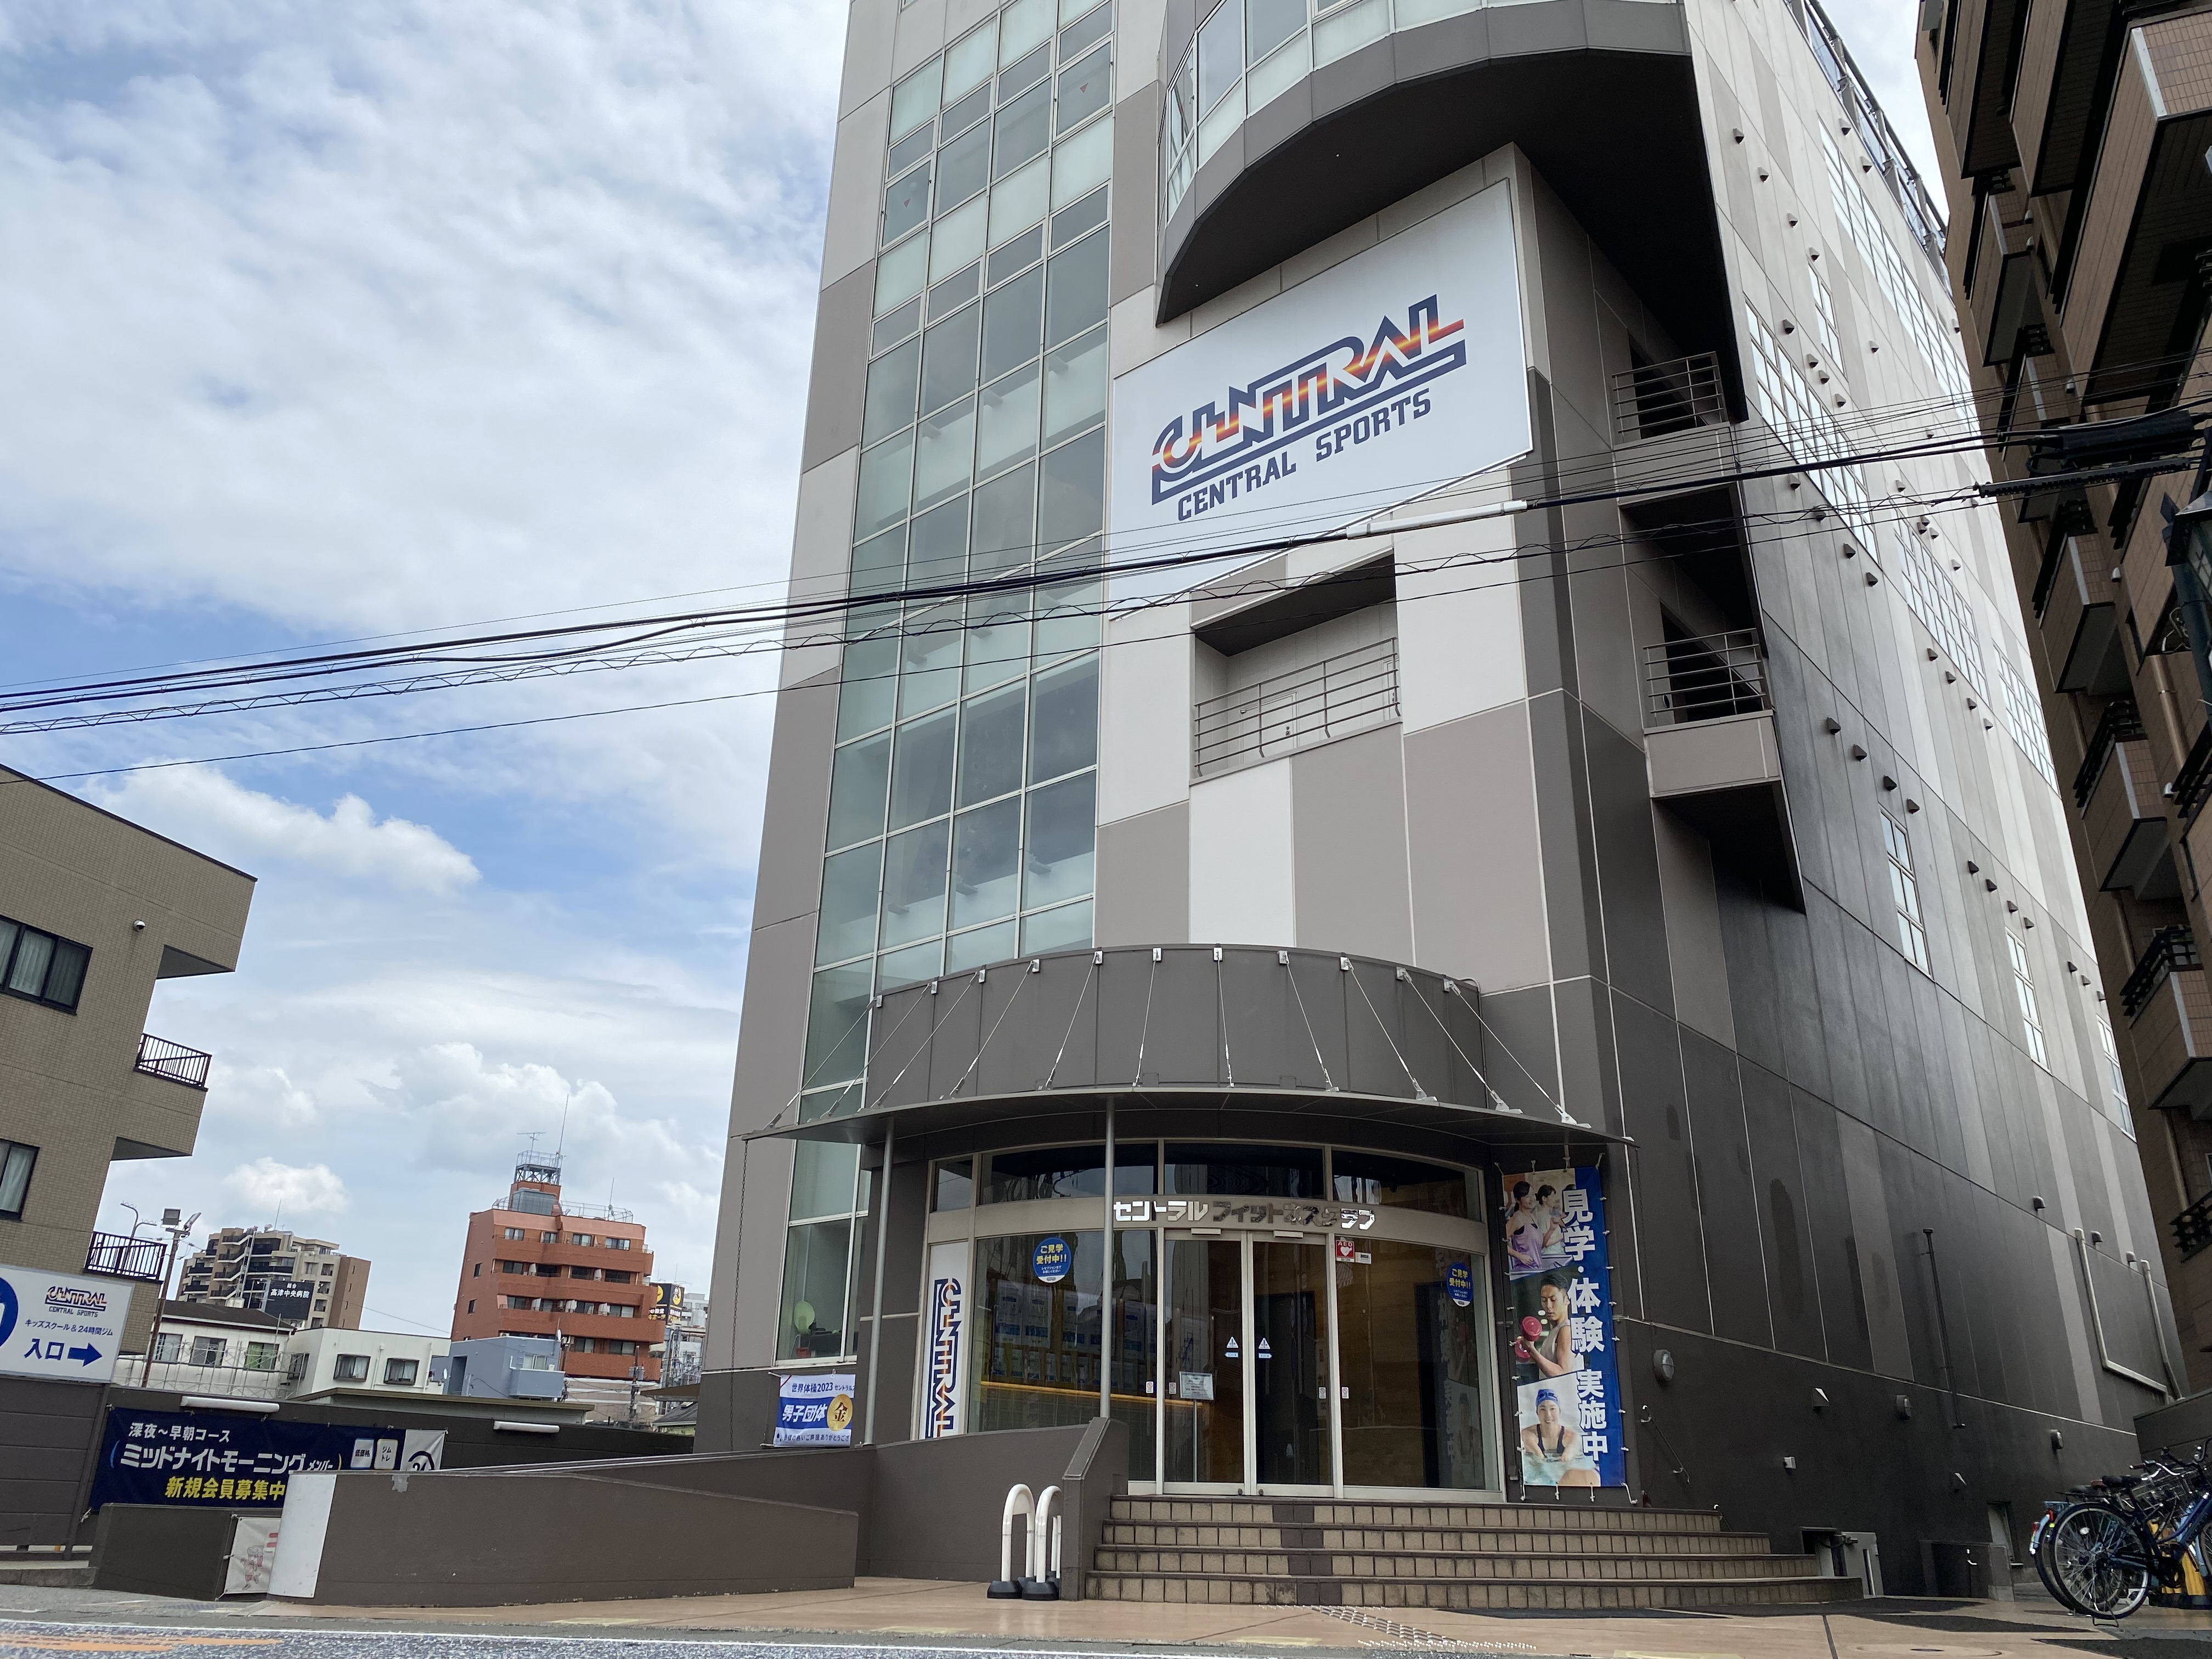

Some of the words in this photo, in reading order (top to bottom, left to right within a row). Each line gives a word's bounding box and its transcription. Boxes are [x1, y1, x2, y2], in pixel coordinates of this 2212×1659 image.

[1152, 294, 1466, 505] CENTRAL
[1177, 451, 1297, 522] CENTRAL
[1316, 388, 1431, 463] SPORTS
[1036, 1254, 1067, 1265] 受付中!!
[1040, 1243, 1064, 1254] ご見学
[1562, 1188, 1605, 1353] 見学・体験
[44, 1286, 108, 1312] CENTRAL
[49, 1306, 74, 1315] CENTRAL
[24, 1338, 65, 1361] 入口
[792, 1382, 834, 1393] 世界体操2023
[782, 1403, 828, 1423] 男子団体
[832, 1402, 848, 1422] 金
[1576, 1369, 1608, 1462] 実施中
[120, 1443, 306, 1474] ミッドナイトモーニング
[381, 1454, 391, 1462] トレ
[165, 1476, 286, 1501] 新規会員募集中
